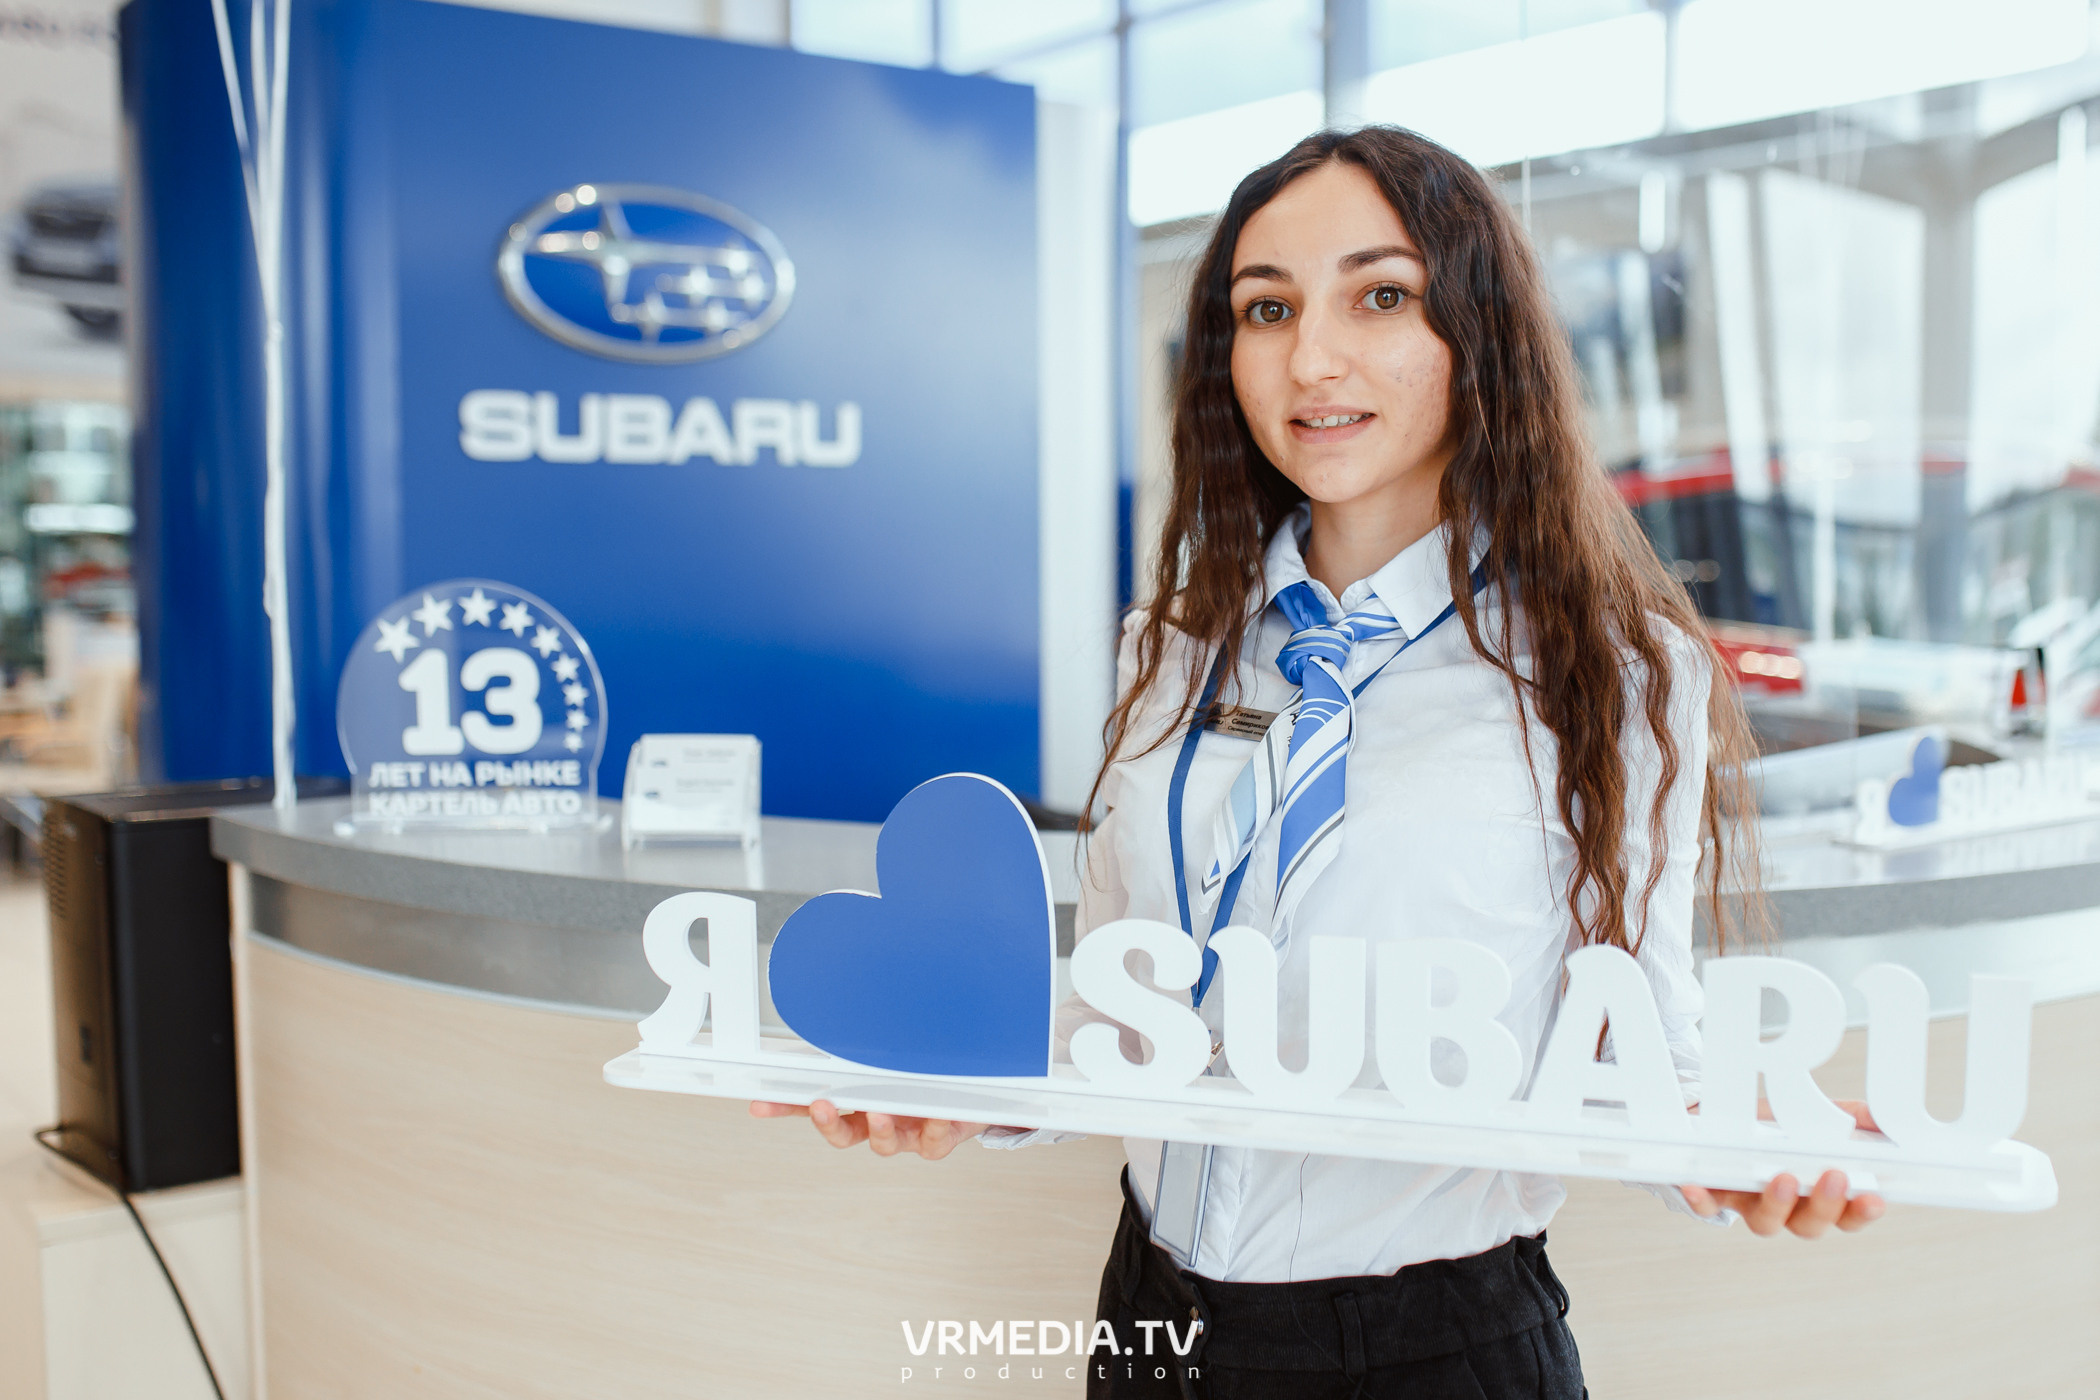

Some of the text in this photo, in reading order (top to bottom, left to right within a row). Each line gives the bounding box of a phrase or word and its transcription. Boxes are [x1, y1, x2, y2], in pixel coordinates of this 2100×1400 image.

[458, 389, 862, 468] SUBARU
[398, 647, 543, 756] 13
[368, 760, 582, 788] ЛЕТ НА РЫНКЕ
[368, 789, 583, 818] КАРТЕЛЬ АВТО
[637, 891, 2034, 1148] Я SUBARU
